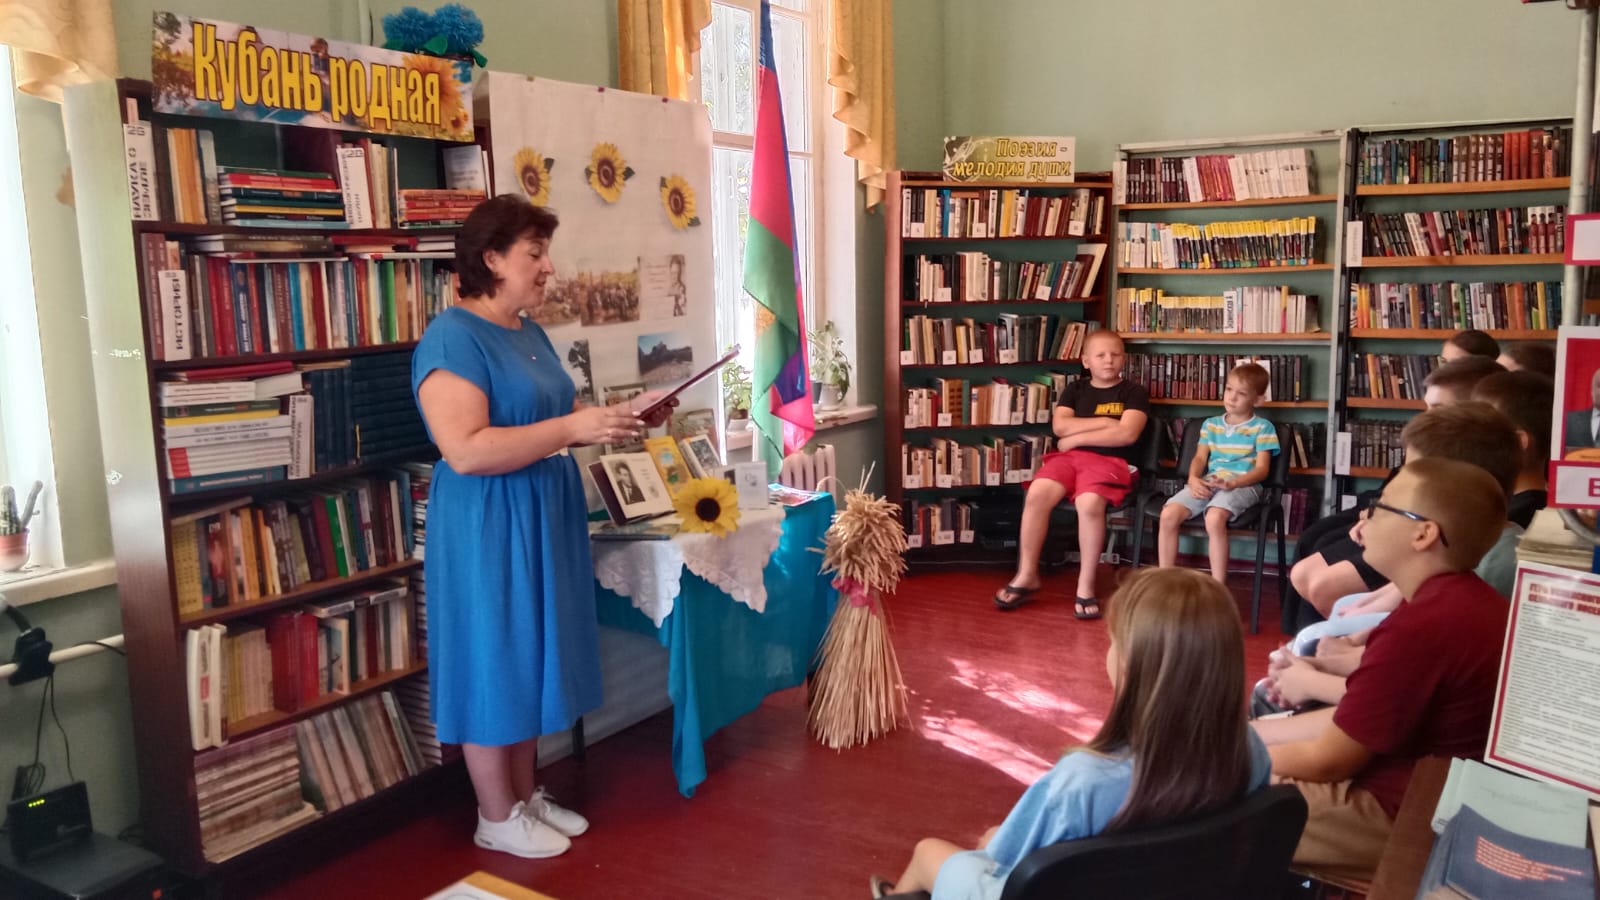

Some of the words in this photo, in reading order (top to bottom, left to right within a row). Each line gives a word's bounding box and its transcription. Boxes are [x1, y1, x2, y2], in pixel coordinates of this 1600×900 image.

[192, 21, 323, 112] Кубань
[329, 56, 441, 131] родная
[996, 138, 1058, 157] Поэзия
[951, 160, 1025, 178] мелодия
[1027, 160, 1072, 182] души
